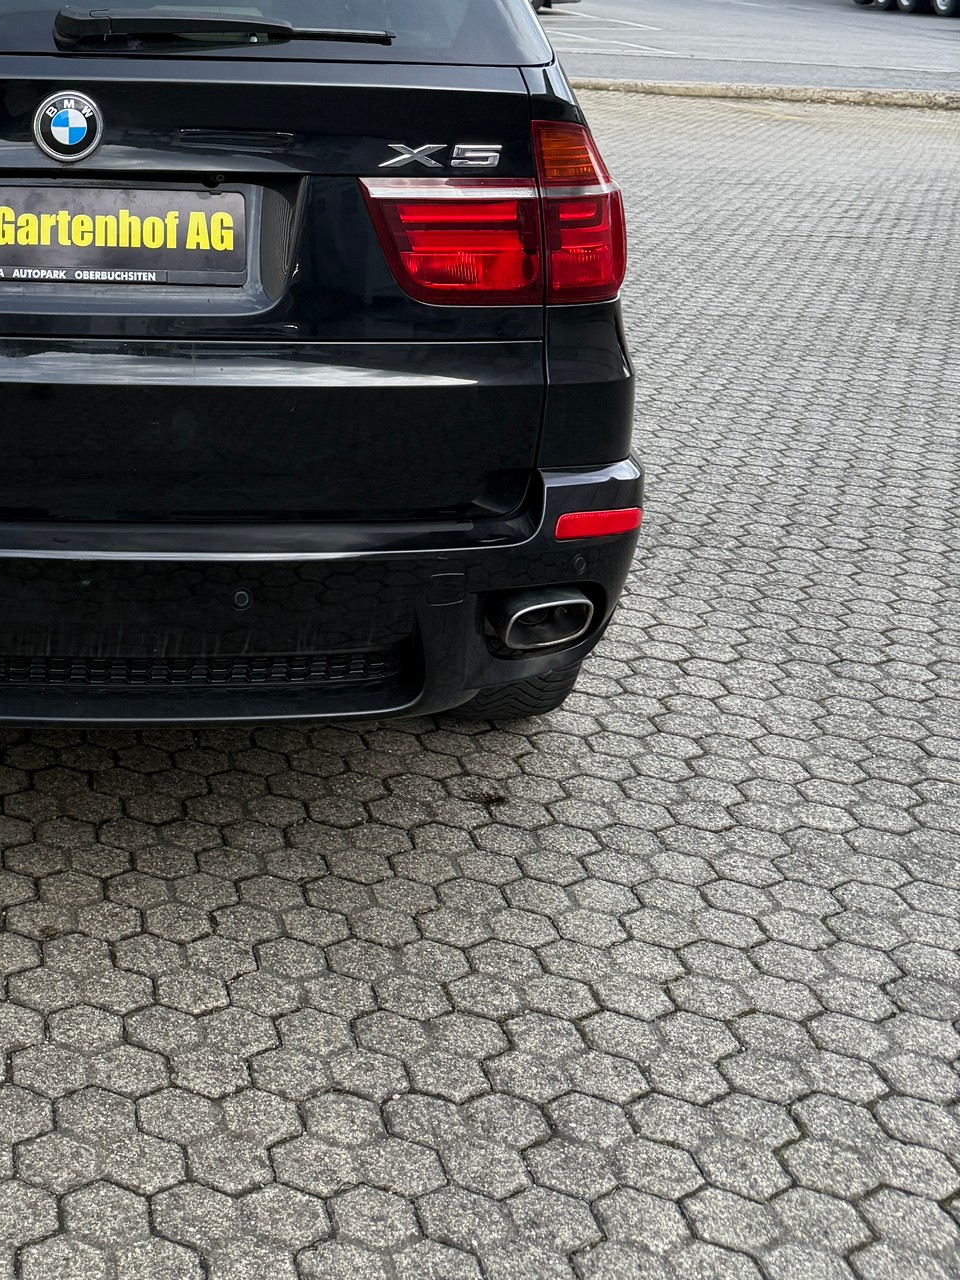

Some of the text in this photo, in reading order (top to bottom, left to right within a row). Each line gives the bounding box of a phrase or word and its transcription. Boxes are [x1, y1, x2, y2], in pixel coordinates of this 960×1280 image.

[45, 99, 94, 118] BMW
[378, 144, 503, 168] X5
[185, 211, 234, 251] AG
[12, 269, 67, 280] AUTOPARK
[74, 270, 157, 282] OBERBUCHSITEN
